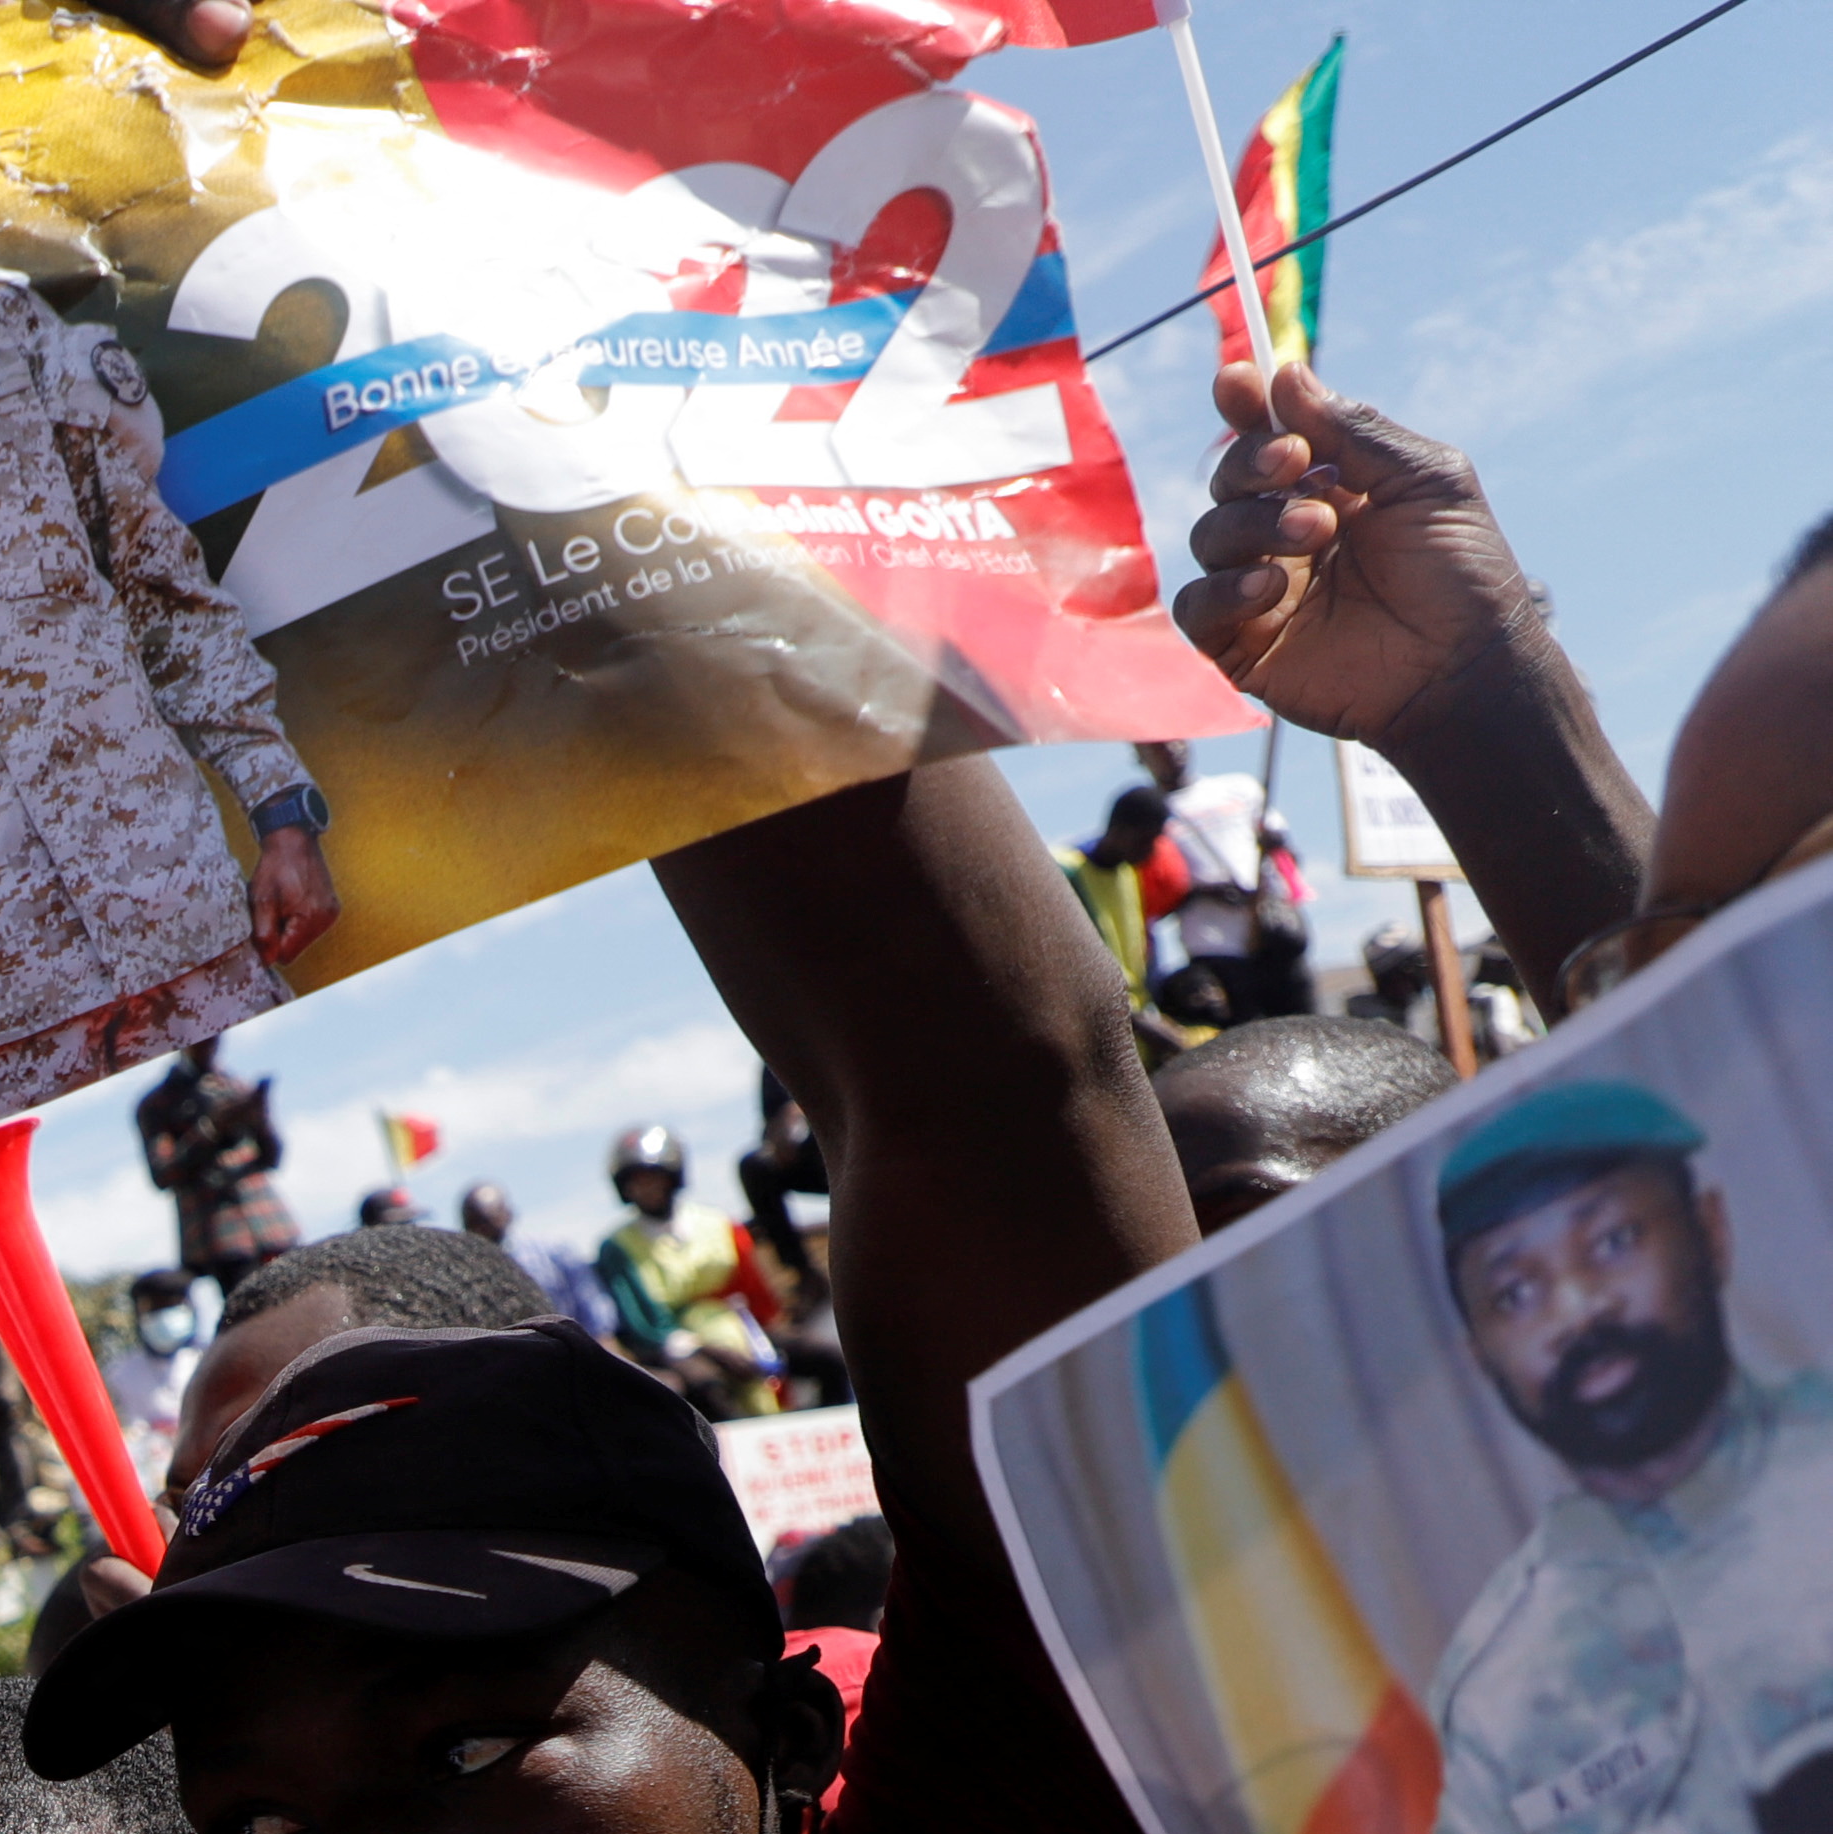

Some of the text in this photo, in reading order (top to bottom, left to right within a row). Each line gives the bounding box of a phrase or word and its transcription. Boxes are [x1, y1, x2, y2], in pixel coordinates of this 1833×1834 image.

[322, 351, 481, 435] Bonne
[738, 326, 866, 372] Année
[441, 551, 520, 623] SE
[526, 537, 602, 587] Le
[456, 579, 621, 667] Président
[625, 566, 674, 600] de
[675, 555, 714, 585] la
